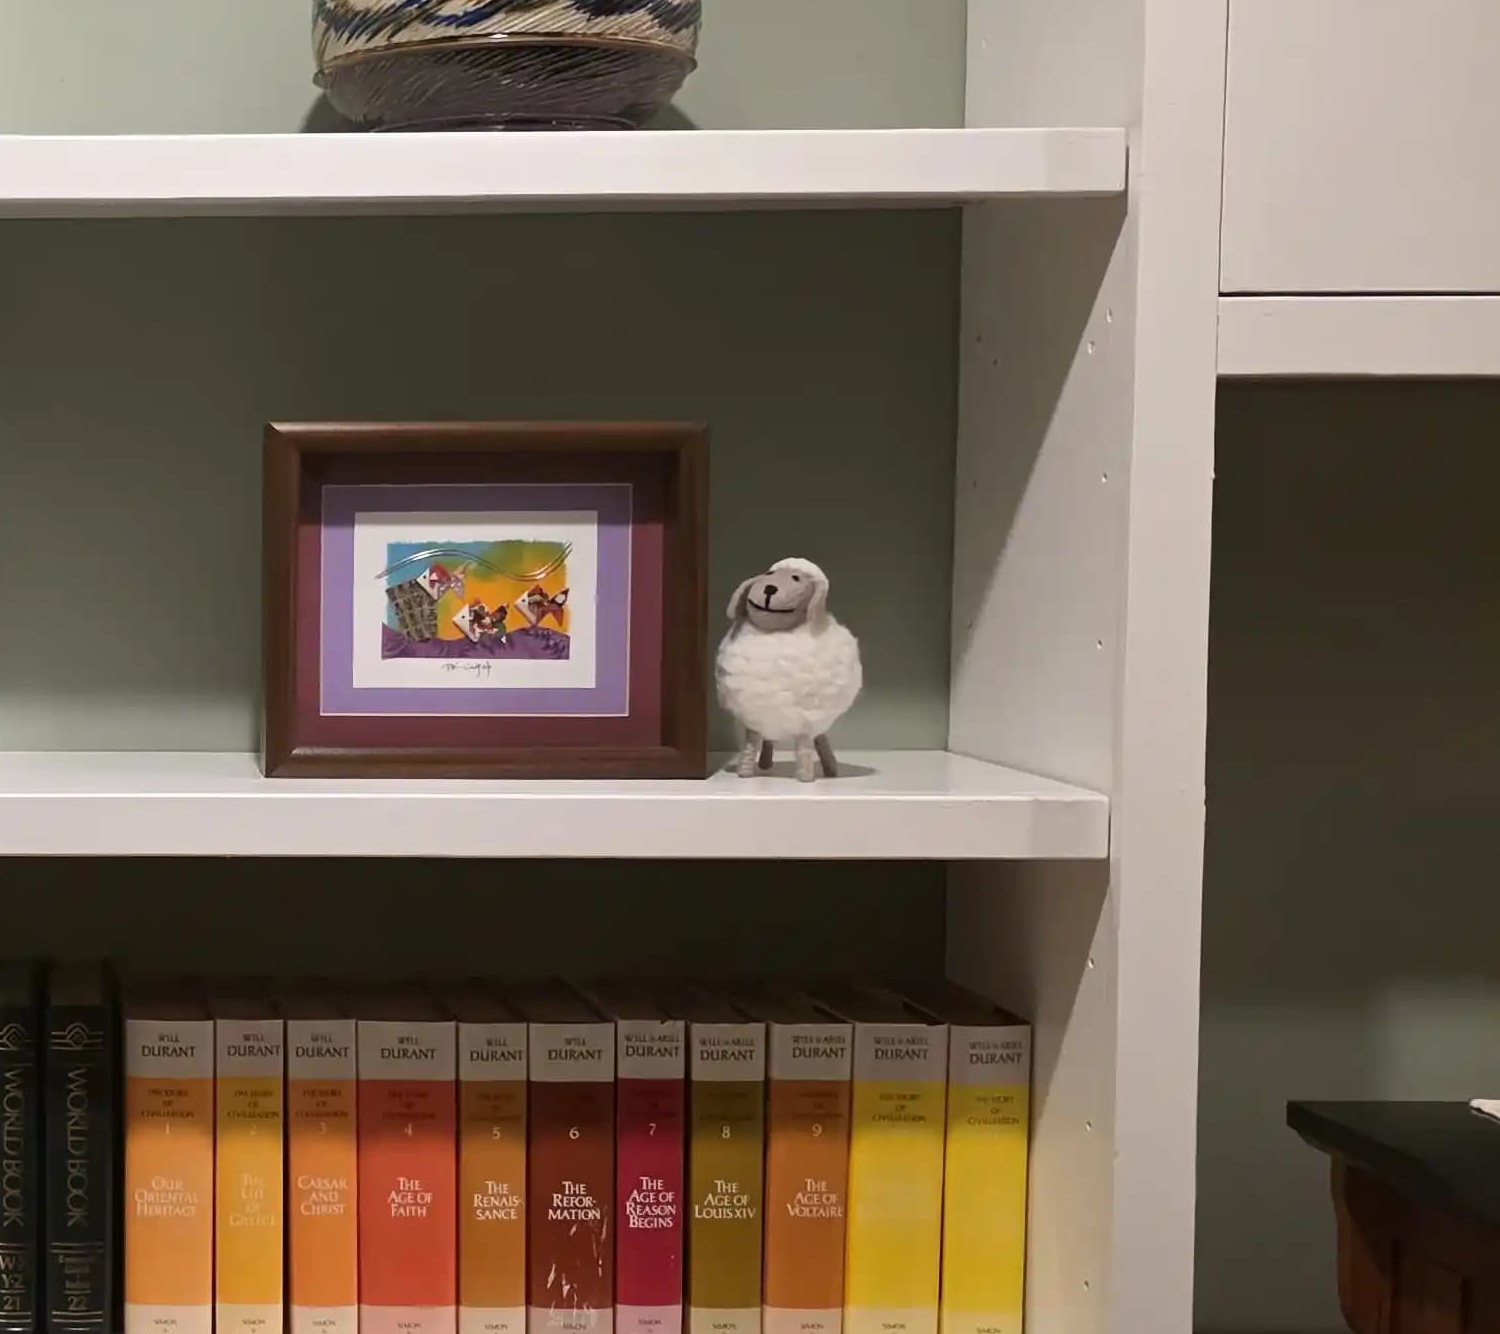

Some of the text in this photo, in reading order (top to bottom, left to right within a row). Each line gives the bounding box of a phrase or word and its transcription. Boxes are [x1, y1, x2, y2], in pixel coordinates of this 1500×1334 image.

[141, 1045, 197, 1058] DURANT
[226, 1044, 282, 1057] DURANT
[295, 1046, 350, 1059] DURANT
[380, 1047, 437, 1060] DURANT
[469, 1049, 525, 1062] DURANT
[547, 1049, 604, 1062] DURANT
[624, 1045, 680, 1058] DURANT
[699, 1048, 756, 1062] DURANT
[791, 1046, 847, 1060] DURANT
[874, 1047, 929, 1061] DURANT
[969, 1052, 1023, 1065] DURANT
[403, 1123, 414, 1137] 4
[492, 1125, 501, 1140] 5
[569, 1126, 580, 1140] 6
[647, 1123, 657, 1137] 7
[721, 1125, 732, 1140] 8
[811, 1123, 823, 1137] 9
[297, 1175, 349, 1191] CAESAR
[396, 1177, 422, 1191] THE
[484, 1180, 510, 1195] THE
[561, 1180, 587, 1195] THE
[639, 1176, 664, 1191] THE
[714, 1179, 740, 1193] THE
[804, 1178, 830, 1193] THE
[133, 1190, 199, 1205] ORIENTAL
[308, 1191, 339, 1204] AND
[387, 1191, 433, 1205] AGE OF
[552, 1193, 597, 1208] REFOR-
[628, 1190, 676, 1204] AGE OF
[703, 1192, 751, 1207] AGE OF
[793, 1191, 841, 1205] AGE OF
[300, 1201, 347, 1216] CHRIST
[391, 1203, 428, 1219] FAITH
[475, 1207, 519, 1220] SANCE
[547, 1207, 602, 1221] MATION
[625, 1202, 677, 1216] REASON
[694, 1205, 757, 1220] LOUIS XIV
[786, 1204, 844, 1219] VOLTAIRE
[628, 1215, 674, 1228] BEGINS
